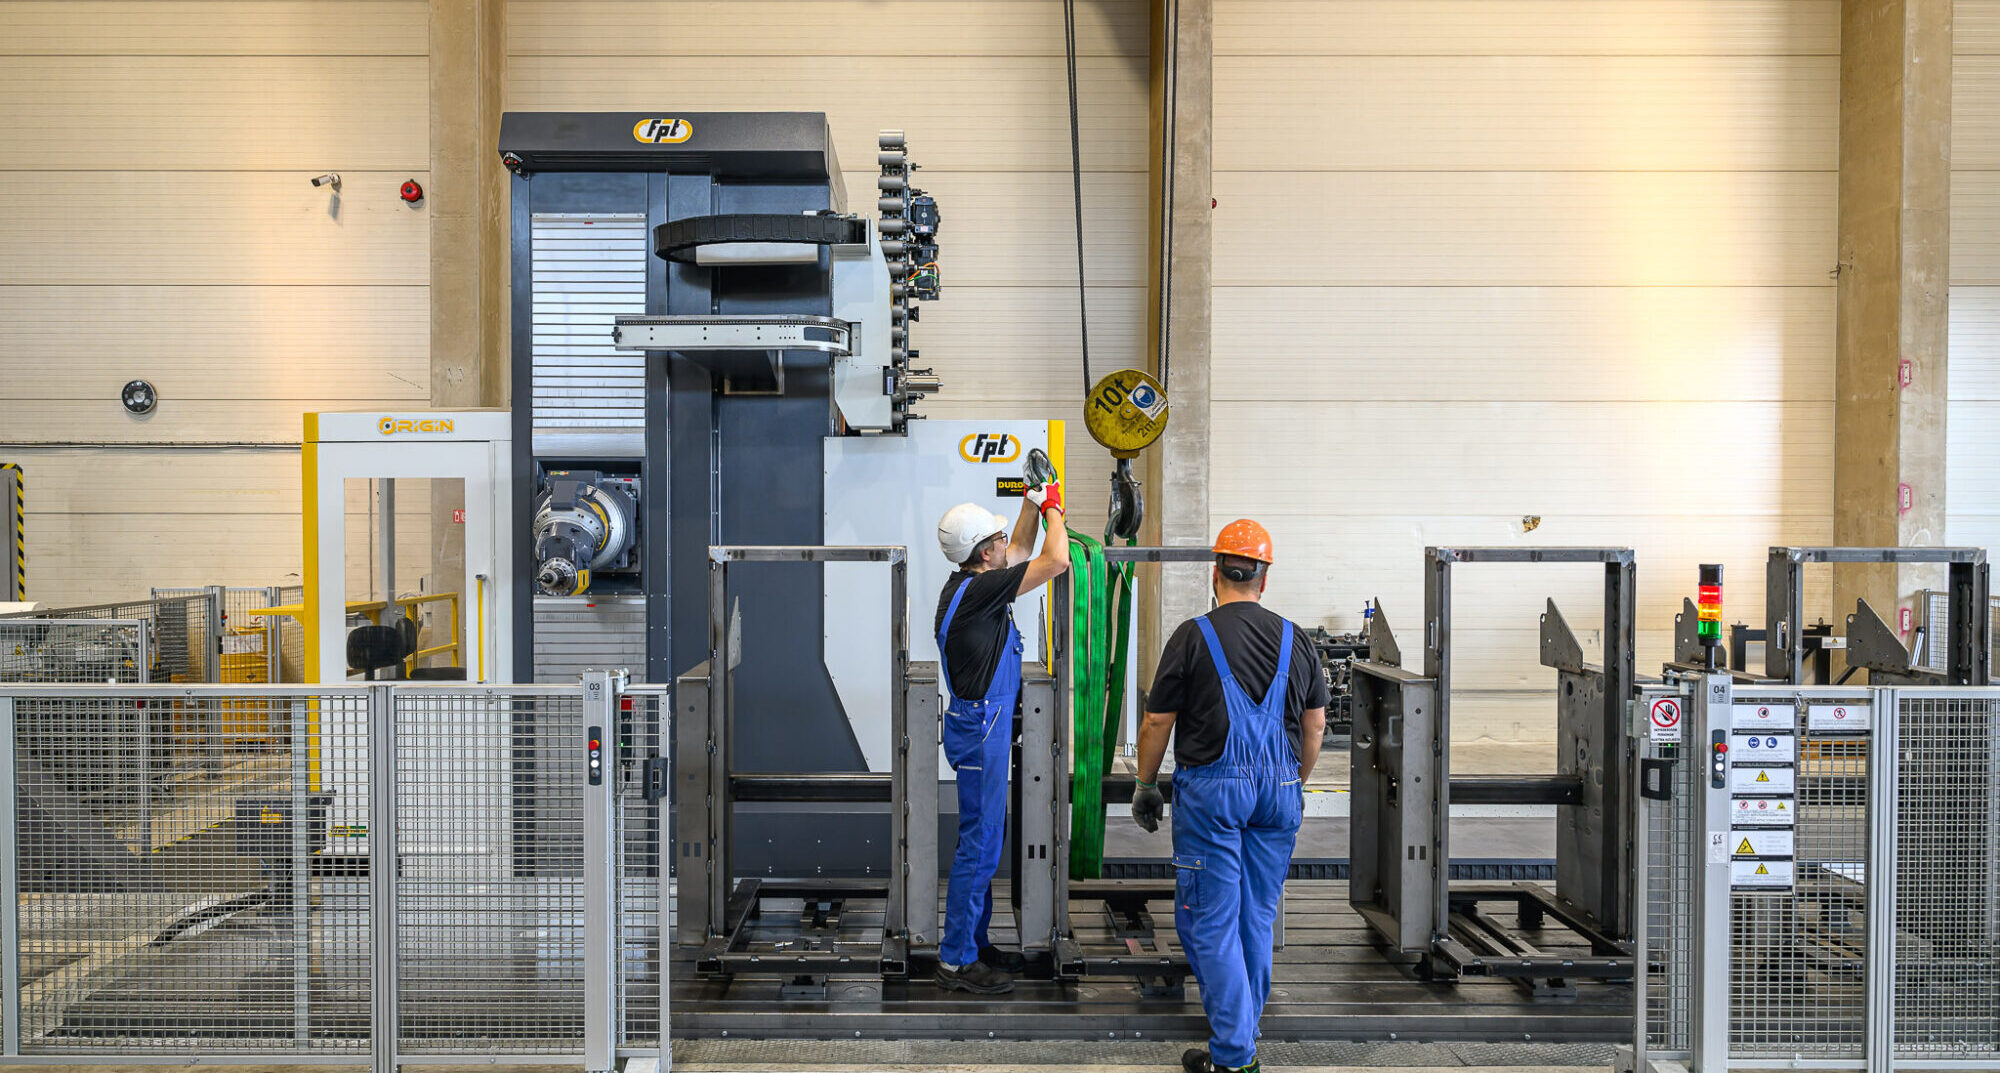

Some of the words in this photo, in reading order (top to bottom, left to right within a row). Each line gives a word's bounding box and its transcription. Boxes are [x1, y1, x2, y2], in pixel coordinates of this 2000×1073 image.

[1095, 378, 1132, 414] 10t
[998, 481, 1025, 489] DURO
[589, 682, 601, 691] 03
[1713, 685, 1725, 694] 04
